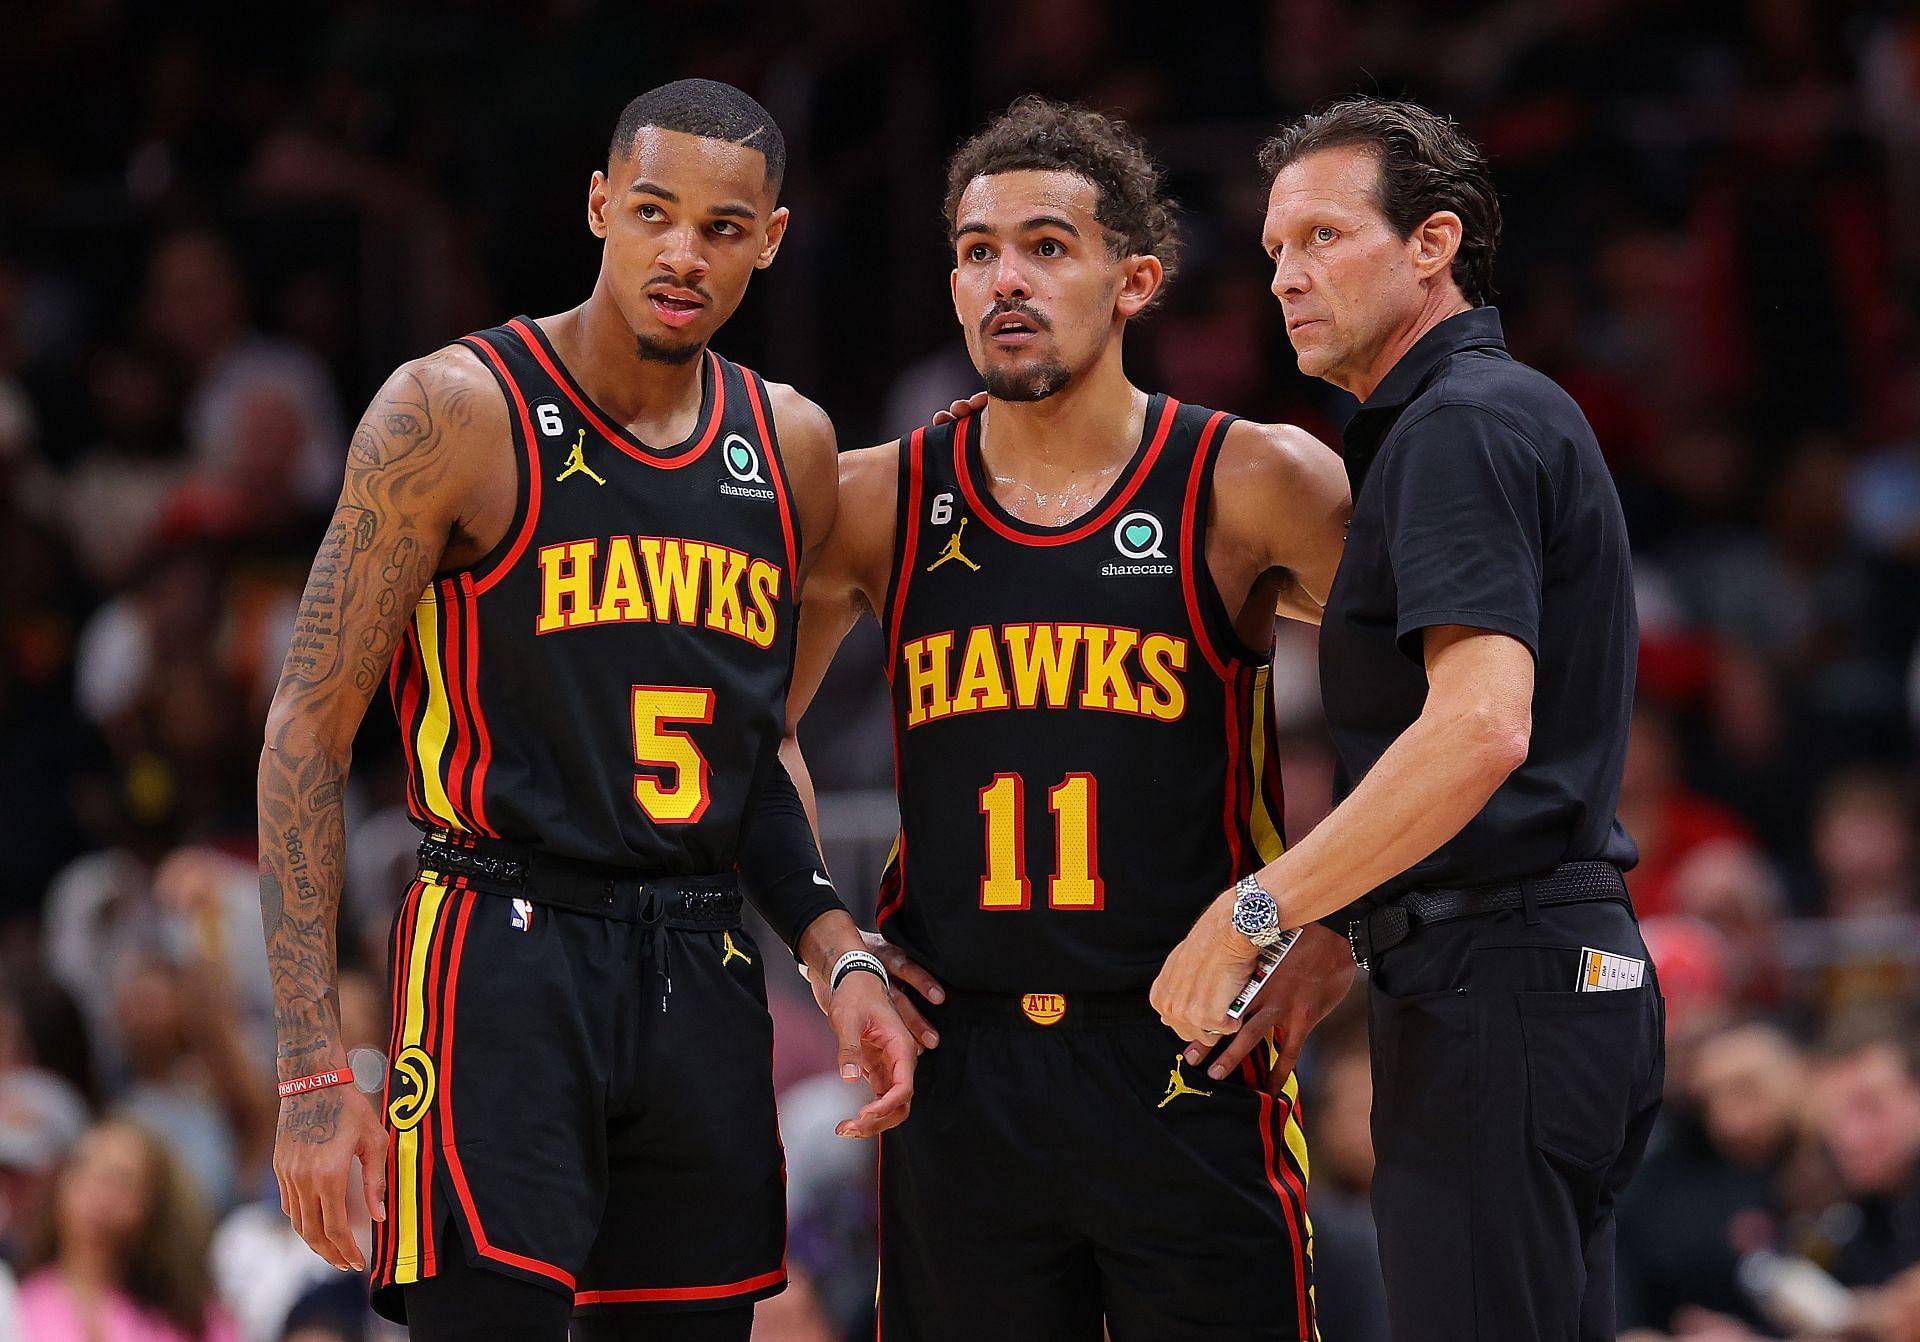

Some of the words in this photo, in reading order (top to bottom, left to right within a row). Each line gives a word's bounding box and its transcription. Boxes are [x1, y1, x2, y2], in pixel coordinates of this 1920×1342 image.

[536, 403, 565, 437] 6
[719, 482, 775, 500] sharecare
[930, 492, 953, 525] 6
[1101, 562, 1174, 577] sharecare
[535, 535, 782, 650] HAWKS
[903, 622, 1189, 731] HAWKS
[631, 685, 716, 824] 5
[978, 771, 1105, 911] 11
[512, 917, 524, 929] NBA
[1027, 995, 1060, 1012] ATL
[309, 1072, 338, 1089] RILEY
